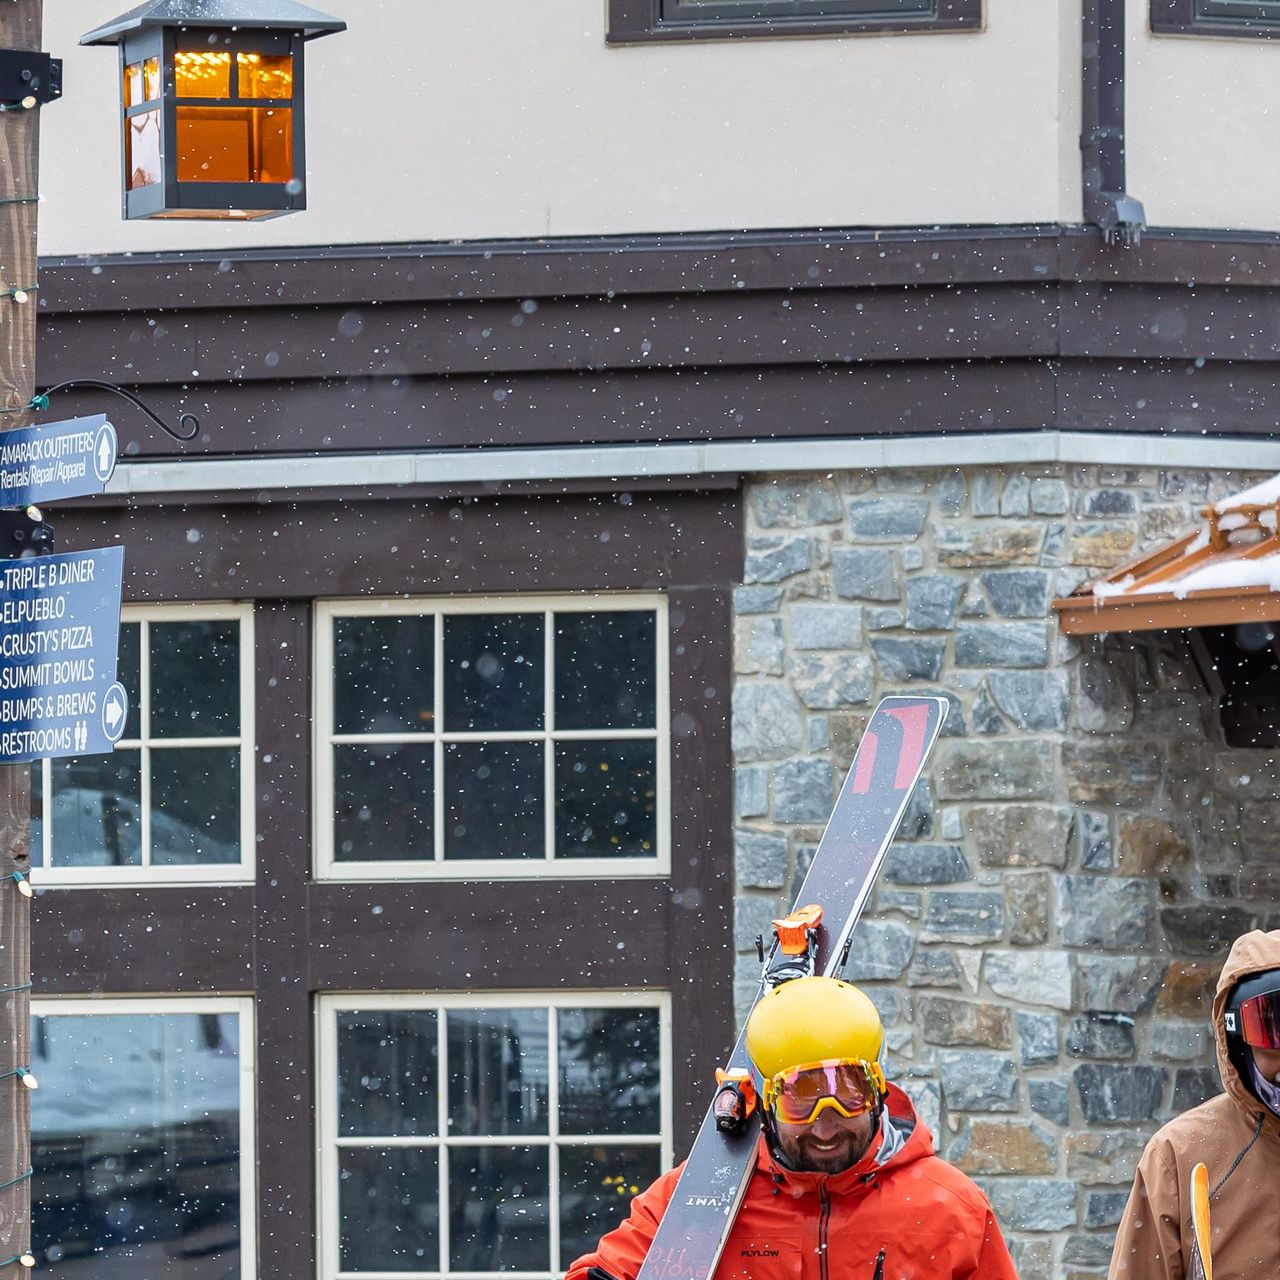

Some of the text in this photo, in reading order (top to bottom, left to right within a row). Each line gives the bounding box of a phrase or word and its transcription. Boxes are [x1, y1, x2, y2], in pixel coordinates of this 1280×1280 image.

[44, 431, 94, 458] OUTFITTERS
[4, 559, 95, 591] TRIPLE B DINER
[3, 626, 93, 657] CRUSTY'S PIZZA
[2, 658, 95, 690] SUMMIT BOWLS
[2, 691, 96, 723] BUMPS & BREWS
[2, 728, 71, 756] RESTROOMS
